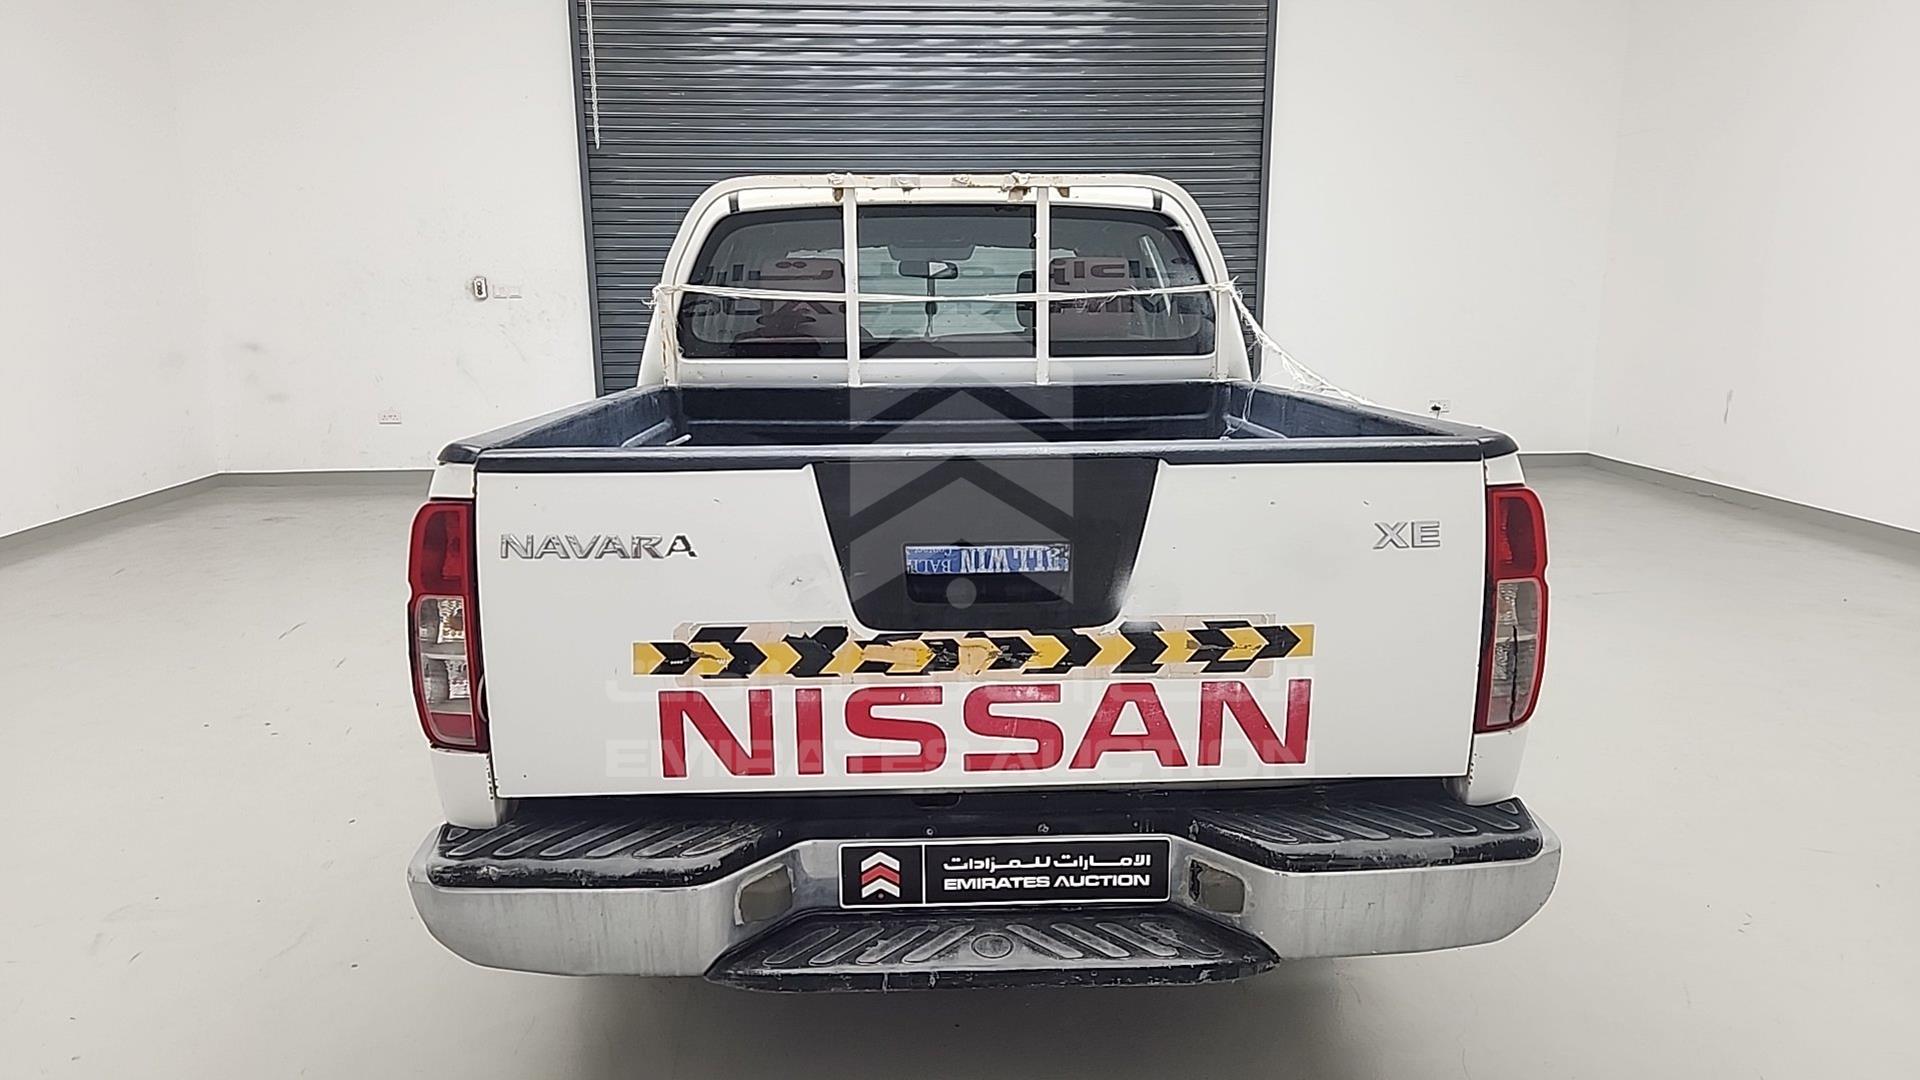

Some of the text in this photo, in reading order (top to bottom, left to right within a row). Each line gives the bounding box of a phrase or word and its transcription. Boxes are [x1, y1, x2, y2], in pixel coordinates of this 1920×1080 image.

[499, 533, 698, 560] NAVARA
[1373, 520, 1441, 550] XE
[657, 677, 1313, 779] NISSAN
[943, 874, 1151, 891] EMIRATES AUCTION
